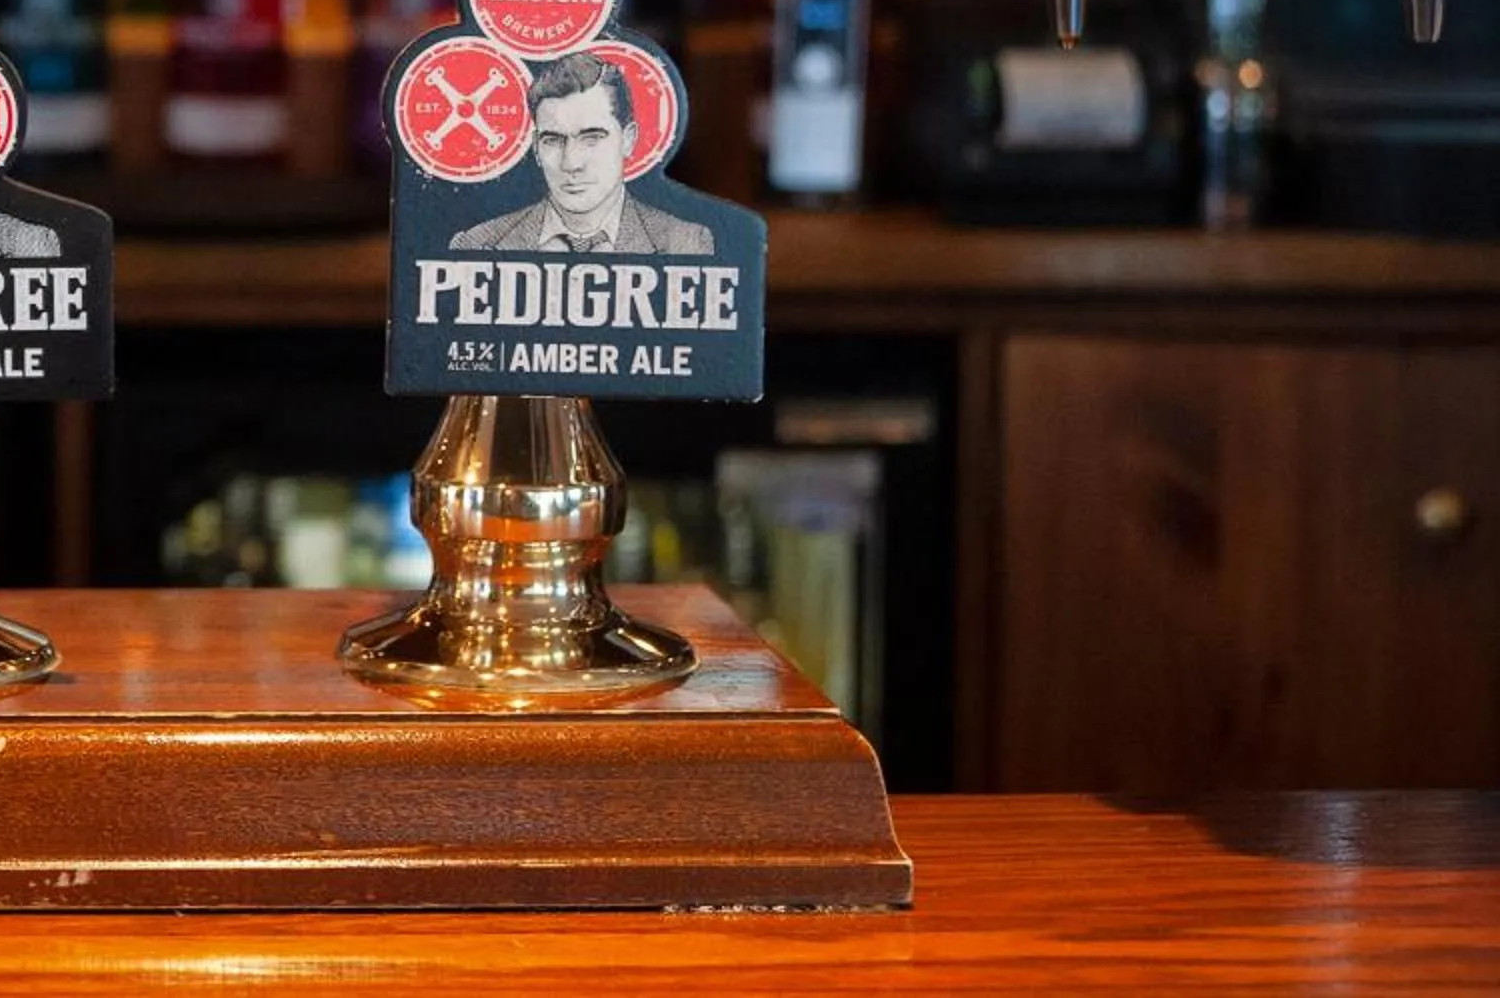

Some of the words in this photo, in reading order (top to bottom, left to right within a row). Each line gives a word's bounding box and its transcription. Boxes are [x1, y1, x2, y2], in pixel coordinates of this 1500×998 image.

[501, 13, 575, 40] BREWERY
[416, 260, 739, 331] PEDIGREE
[509, 343, 619, 375] AMBER
[630, 346, 692, 376] ALE
